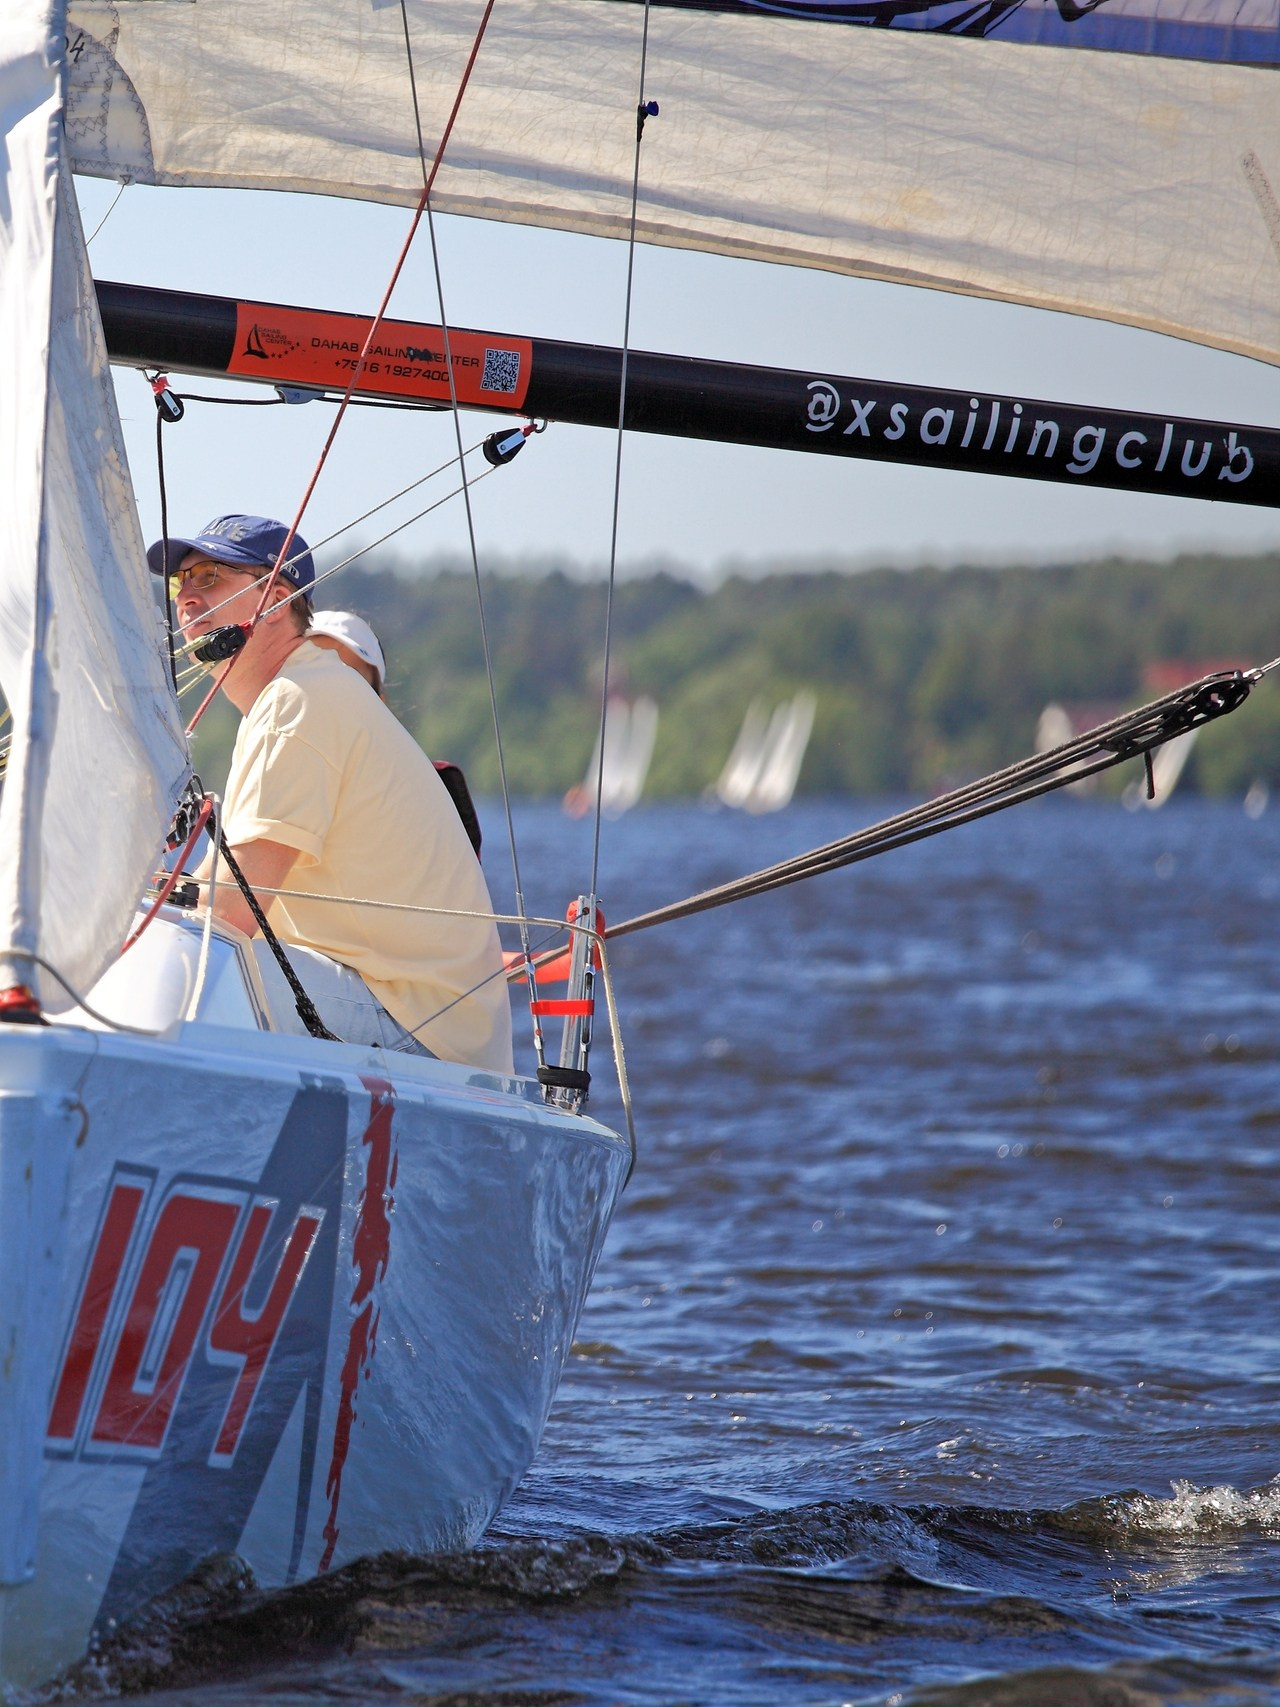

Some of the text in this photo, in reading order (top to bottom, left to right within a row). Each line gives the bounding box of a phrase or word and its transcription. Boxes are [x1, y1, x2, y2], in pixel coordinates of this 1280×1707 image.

[311, 337, 480, 368] DAHAB SAILIN ENTER
[384, 364, 450, 382] 1927400
[805, 380, 1254, 483] @xsailingclub
[45, 1166, 326, 1469] 104
